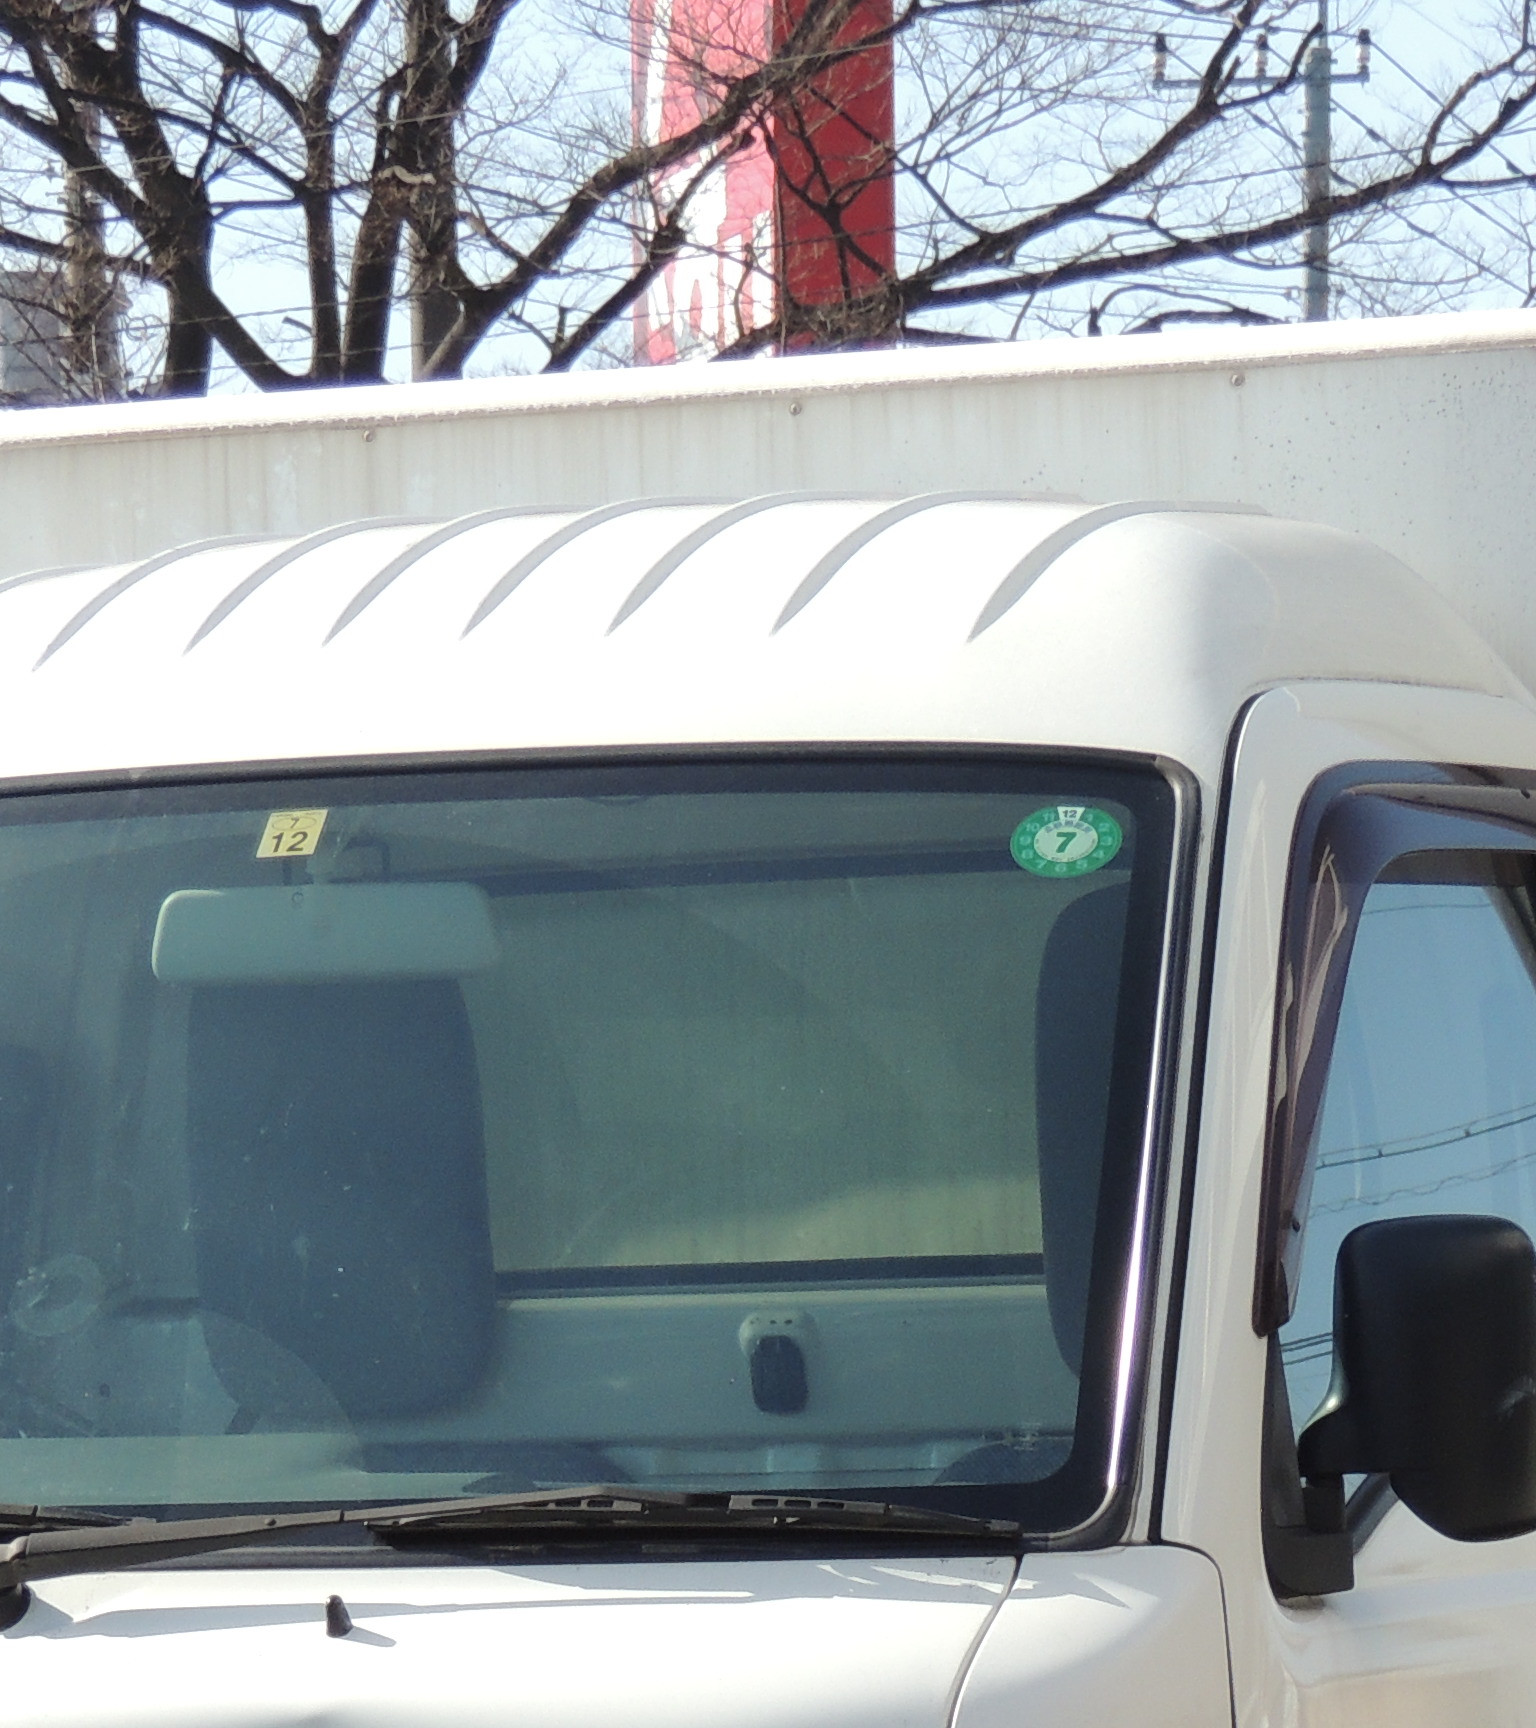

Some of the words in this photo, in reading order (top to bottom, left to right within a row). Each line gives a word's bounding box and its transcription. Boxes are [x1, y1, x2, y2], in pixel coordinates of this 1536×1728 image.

[1062, 809, 1078, 818] 12
[272, 831, 309, 853] 12
[1056, 831, 1078, 854] 7
